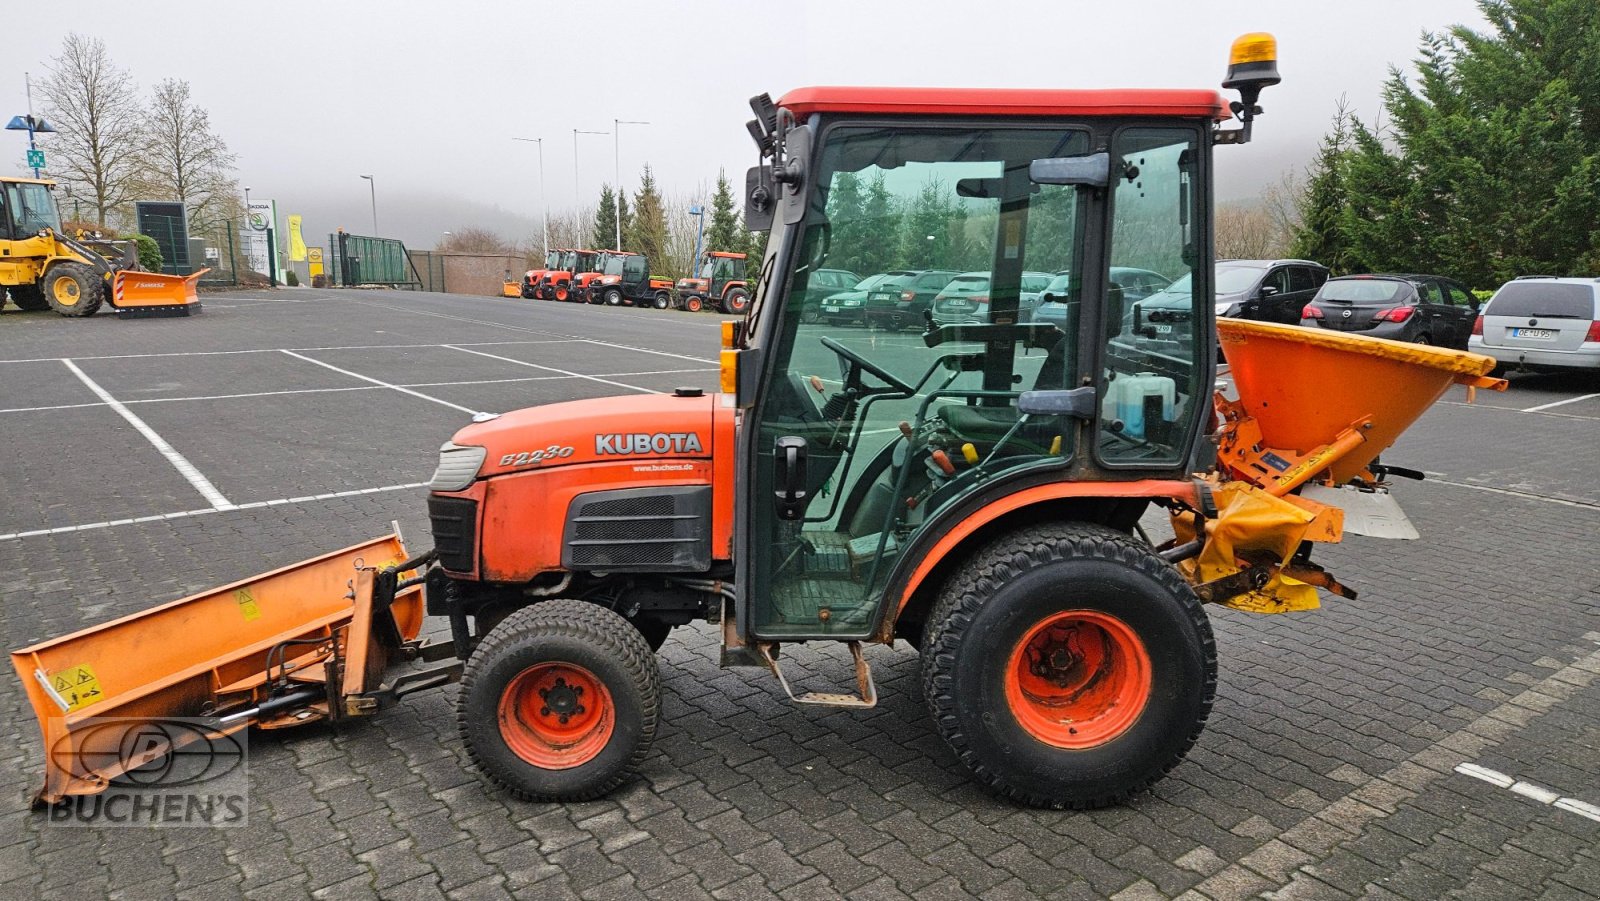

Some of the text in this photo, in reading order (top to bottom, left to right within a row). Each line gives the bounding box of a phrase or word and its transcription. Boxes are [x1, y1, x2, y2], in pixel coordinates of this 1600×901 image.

[594, 433, 703, 455] KUBOTA
[498, 445, 575, 467] B2230
[633, 463, 694, 471] www.buchens.de
